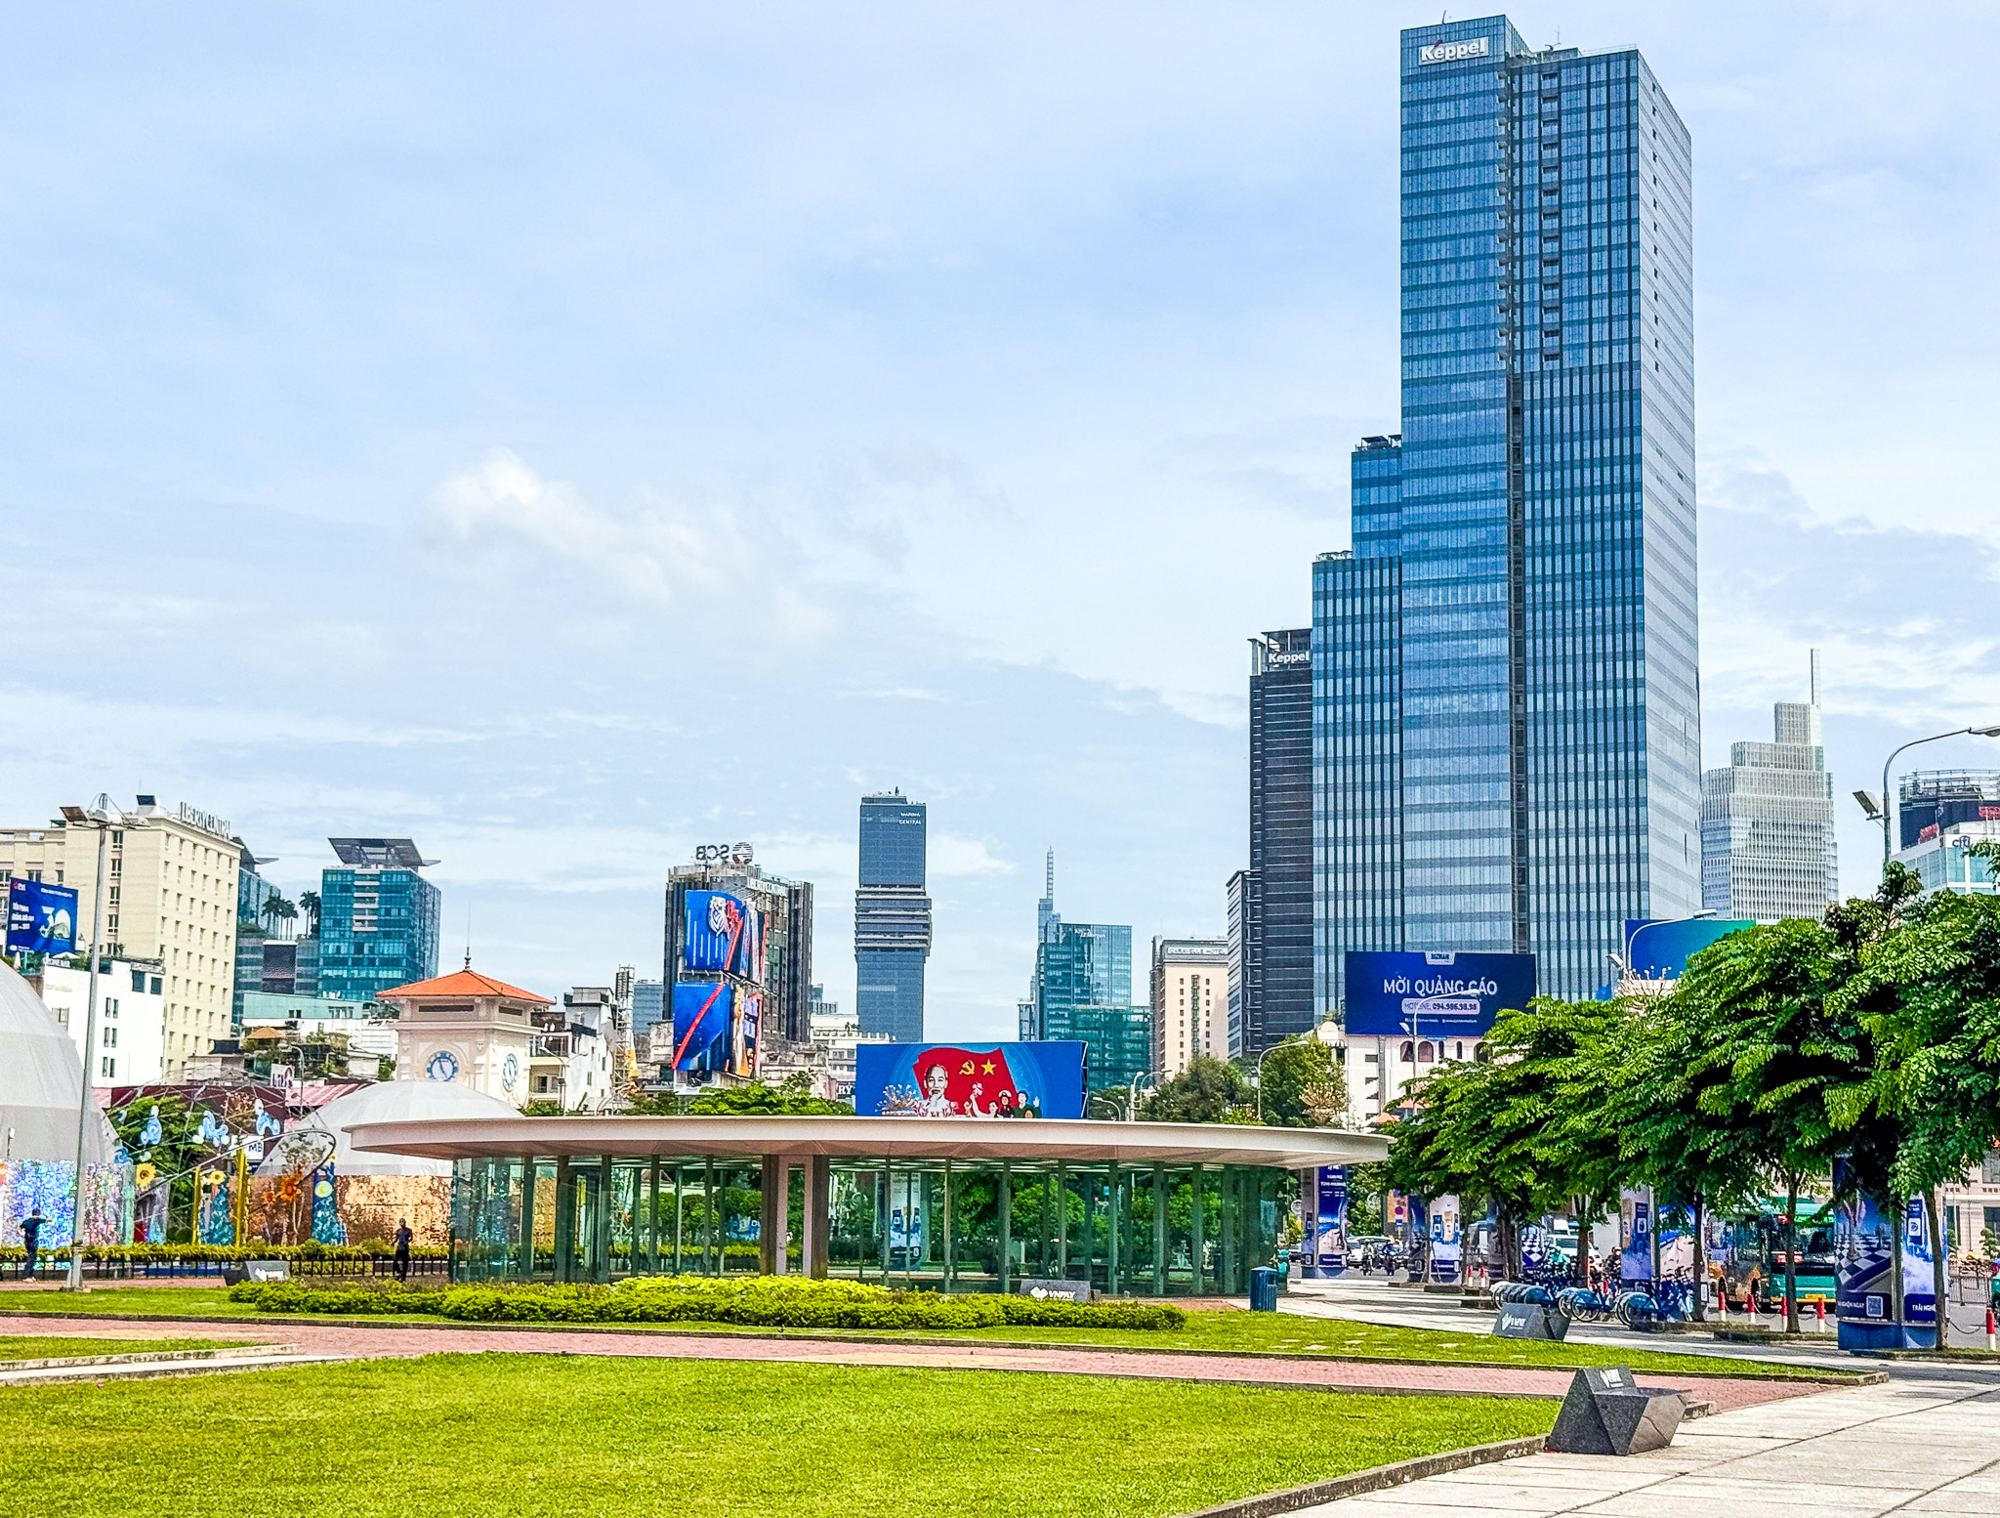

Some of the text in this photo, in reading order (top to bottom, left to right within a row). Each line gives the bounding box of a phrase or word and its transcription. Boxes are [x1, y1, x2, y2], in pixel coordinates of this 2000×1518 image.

[1383, 975, 1410, 994] MỜI
[1414, 974, 1465, 997] QUẢNG
[1048, 1290, 1076, 1299] VNPAY
